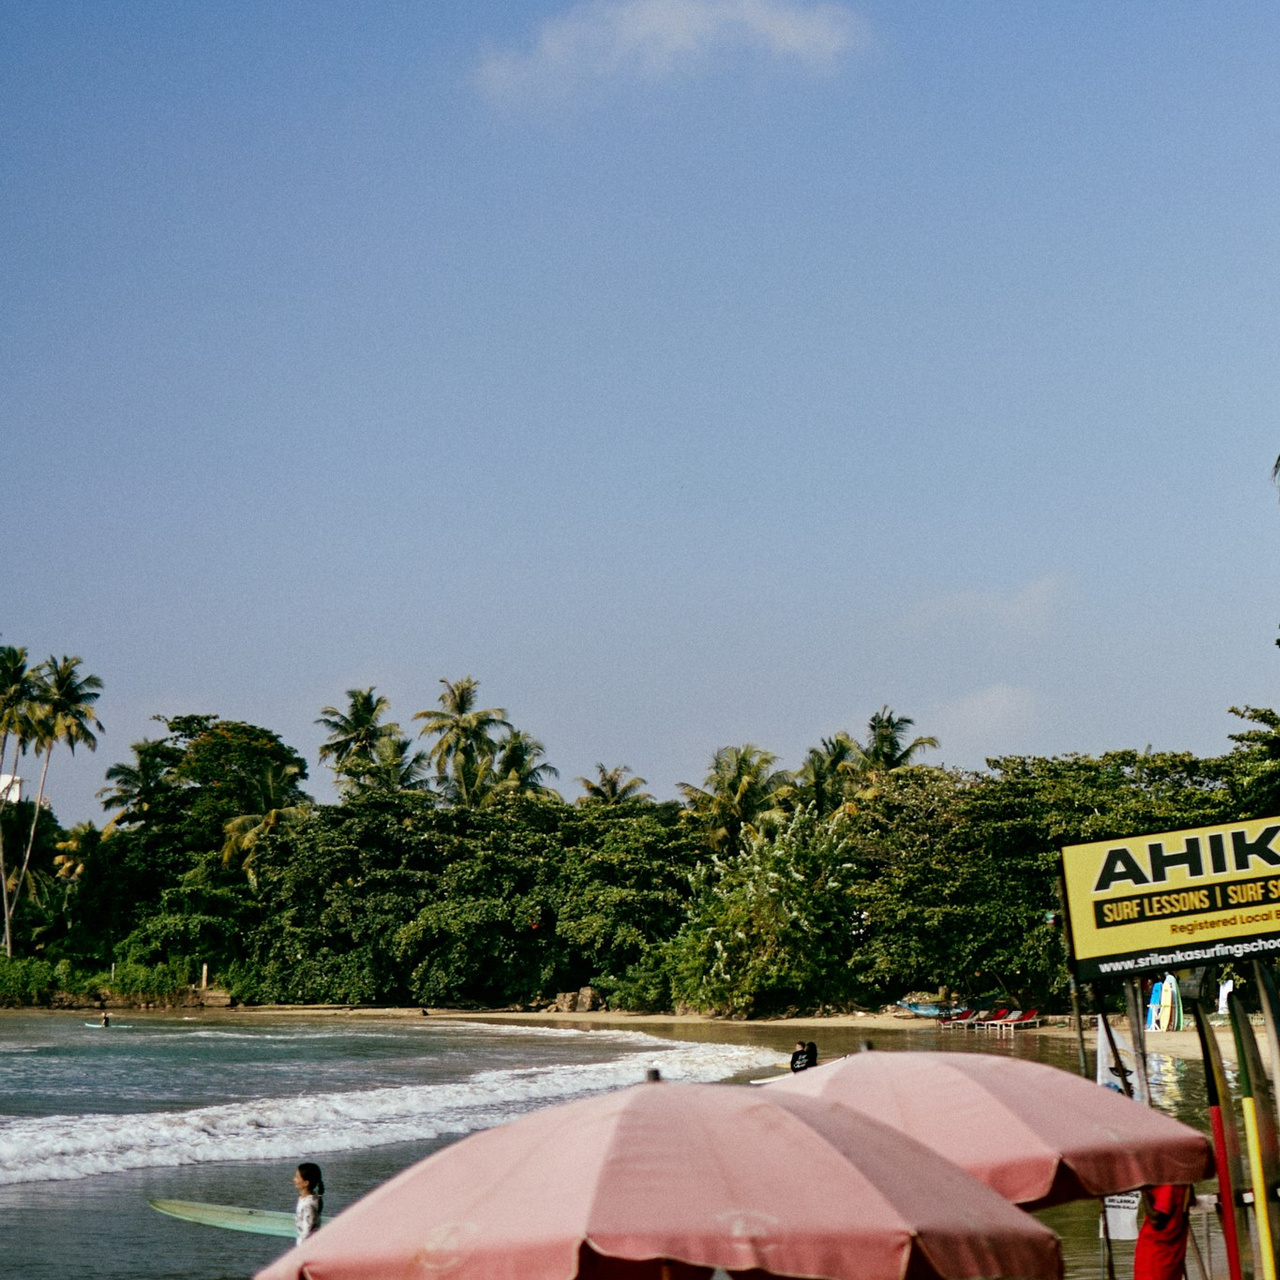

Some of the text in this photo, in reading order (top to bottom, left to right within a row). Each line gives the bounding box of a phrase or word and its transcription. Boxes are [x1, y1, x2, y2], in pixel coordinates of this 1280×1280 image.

[1103, 900, 1141, 923] SURF
[1143, 890, 1211, 916] LESSONS
[1227, 881, 1265, 904] SURF
[1170, 915, 1238, 935] Registered
[1241, 909, 1273, 925] Local
